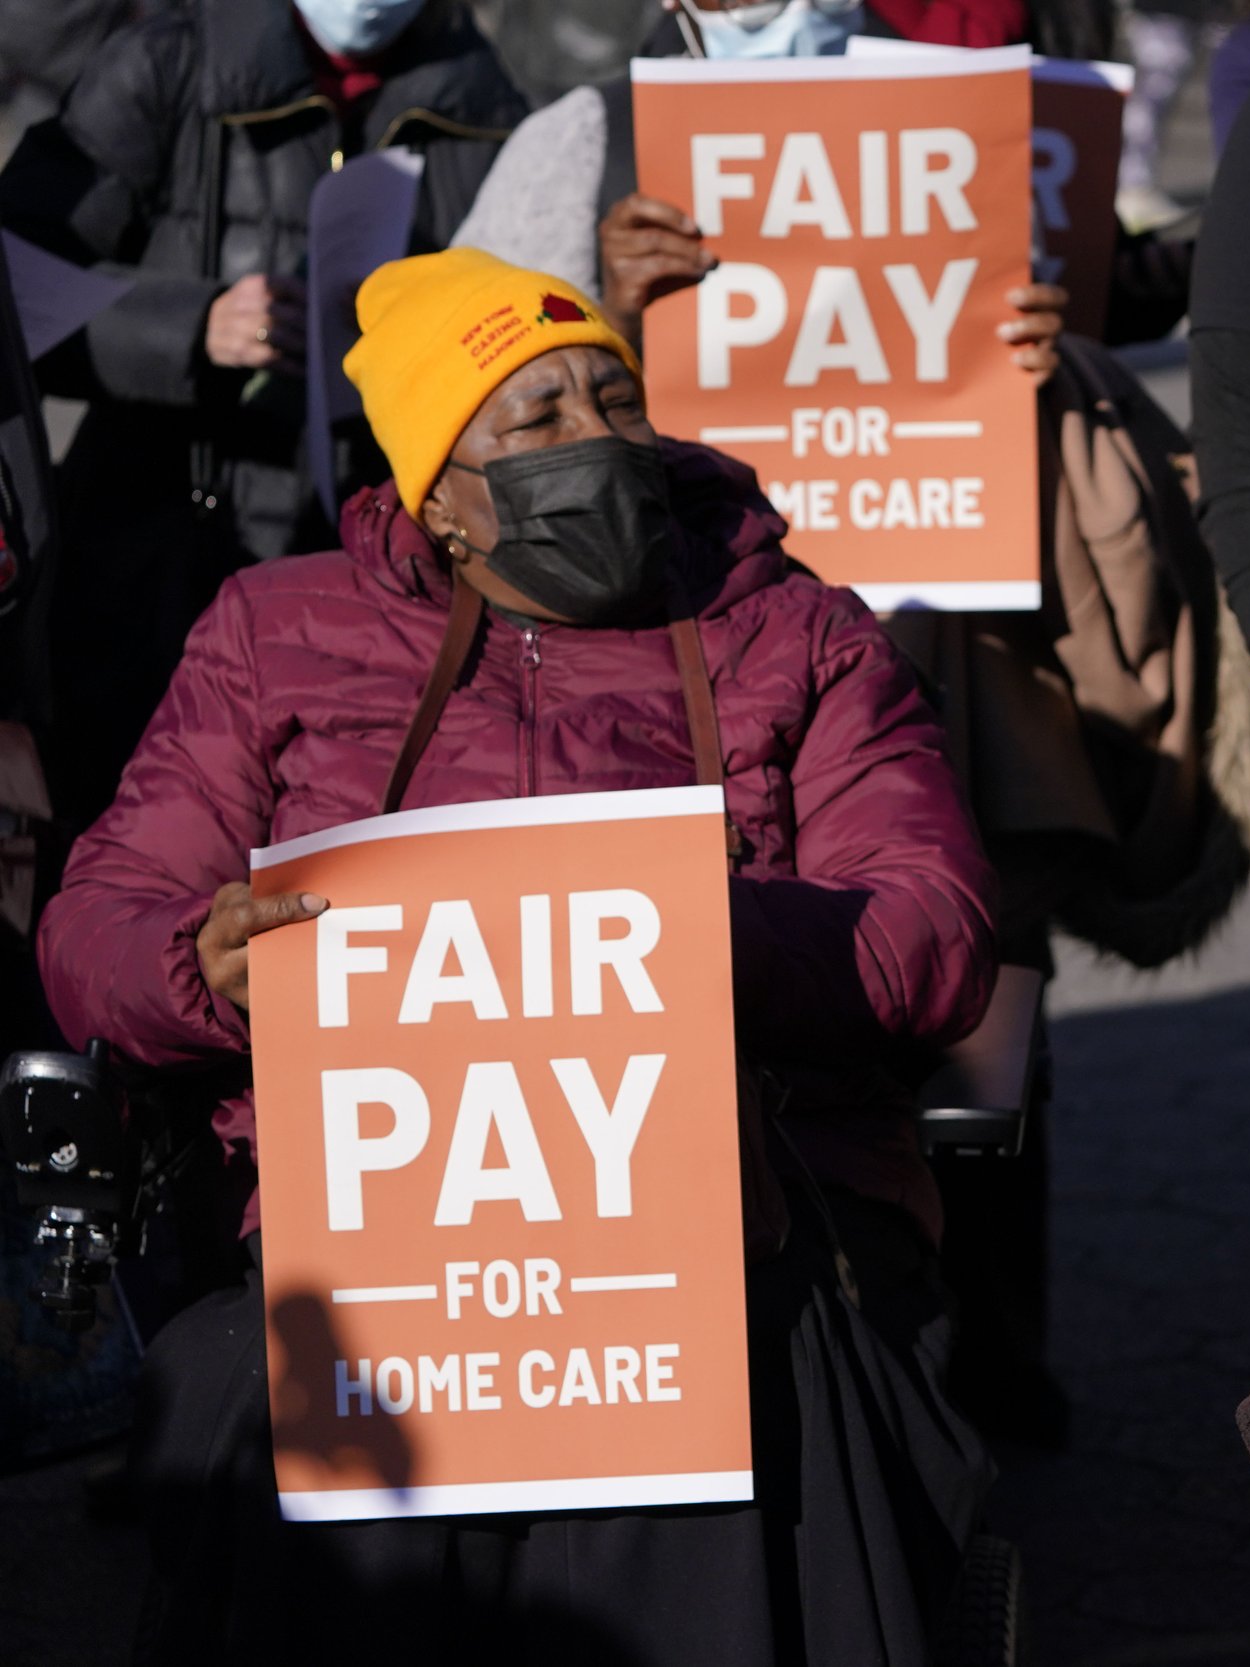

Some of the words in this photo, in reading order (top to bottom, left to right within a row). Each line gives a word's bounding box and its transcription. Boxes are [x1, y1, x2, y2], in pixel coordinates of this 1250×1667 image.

[689, 126, 979, 240] FAIR
[696, 257, 980, 390] PAY
[791, 406, 891, 459] FOR
[767, 479, 841, 532] ME
[848, 476, 986, 531] CARE
[315, 887, 667, 1029] FAIR
[319, 1052, 668, 1233] PAY
[444, 1256, 564, 1321] FOR
[334, 1351, 503, 1417] HOME
[517, 1342, 683, 1409] CARE
